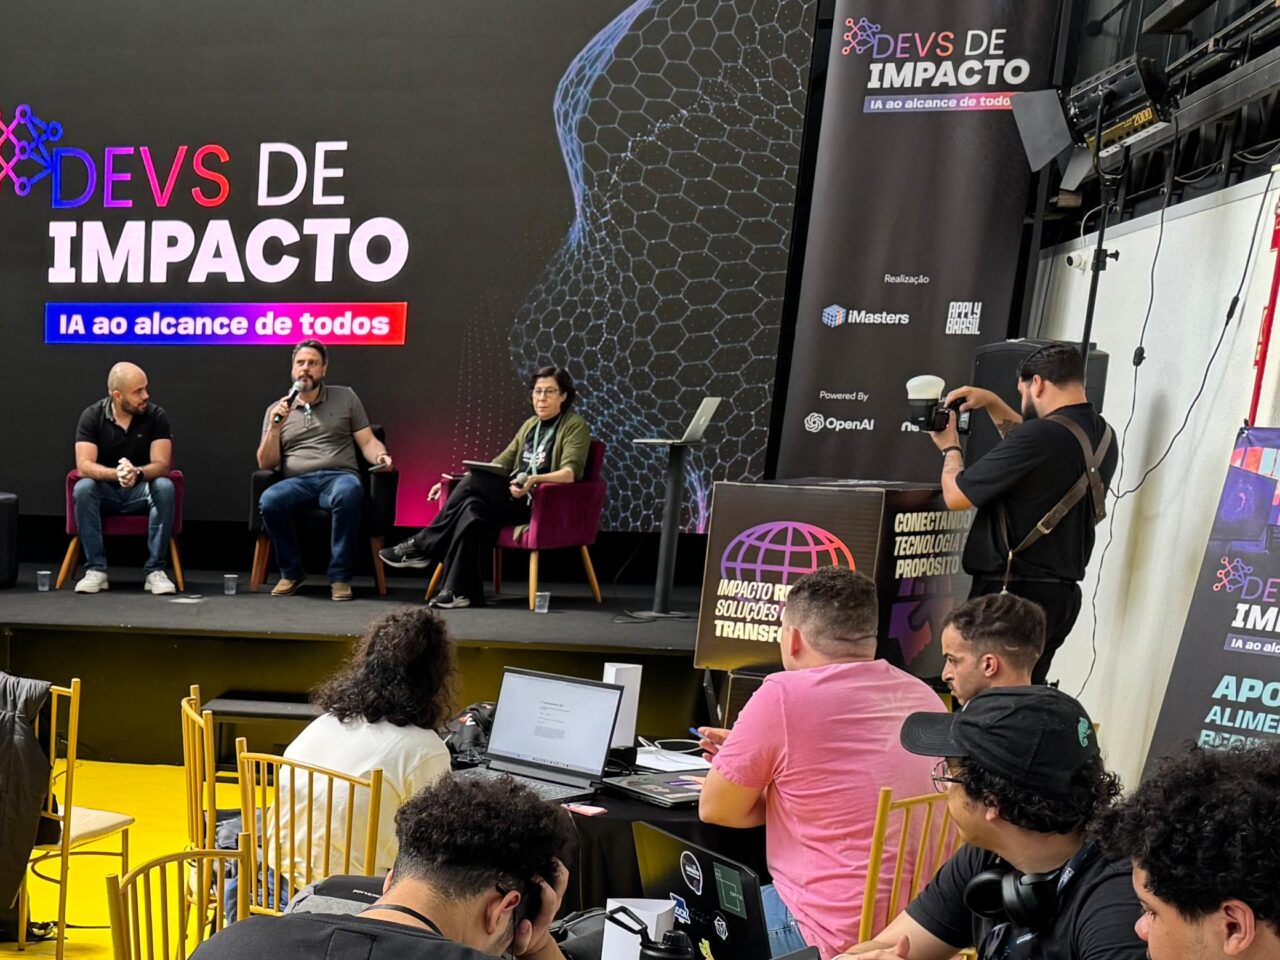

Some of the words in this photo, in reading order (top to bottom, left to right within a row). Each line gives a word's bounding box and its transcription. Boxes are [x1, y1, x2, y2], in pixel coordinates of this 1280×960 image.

[873, 31, 955, 59] DEVS
[964, 28, 1007, 56] DE
[867, 58, 1031, 88] IMPACTO
[870, 100, 883, 109] IA
[886, 100, 902, 109] ao
[904, 97, 957, 109] alcance
[960, 96, 976, 107] de
[980, 95, 1011, 107] todo
[52, 144, 230, 208] DEVS
[257, 141, 348, 206] DE
[48, 216, 410, 283] IMPACTO
[884, 274, 930, 285] Realização
[848, 309, 910, 324] iMasters
[947, 302, 982, 319] APPLY
[59, 314, 85, 335] IA
[92, 318, 128, 336] ao
[134, 311, 248, 336] alcance
[255, 311, 292, 336] de
[299, 311, 390, 335] todos
[945, 317, 981, 335] BRASIL
[819, 390, 856, 400] Powered
[857, 391, 869, 402] By
[825, 417, 875, 431] OpenAI
[894, 511, 971, 533] CONECTANDO
[893, 535, 959, 556] TECNOLOGIA
[895, 554, 960, 579] PROPÓSITO
[717, 579, 773, 600] IMPACTO
[714, 599, 779, 622] SOLUÇÕES
[1231, 638, 1243, 649] IA
[1245, 641, 1261, 650] ao
[1211, 674, 1280, 707] APO
[1204, 705, 1280, 735] ALIME
